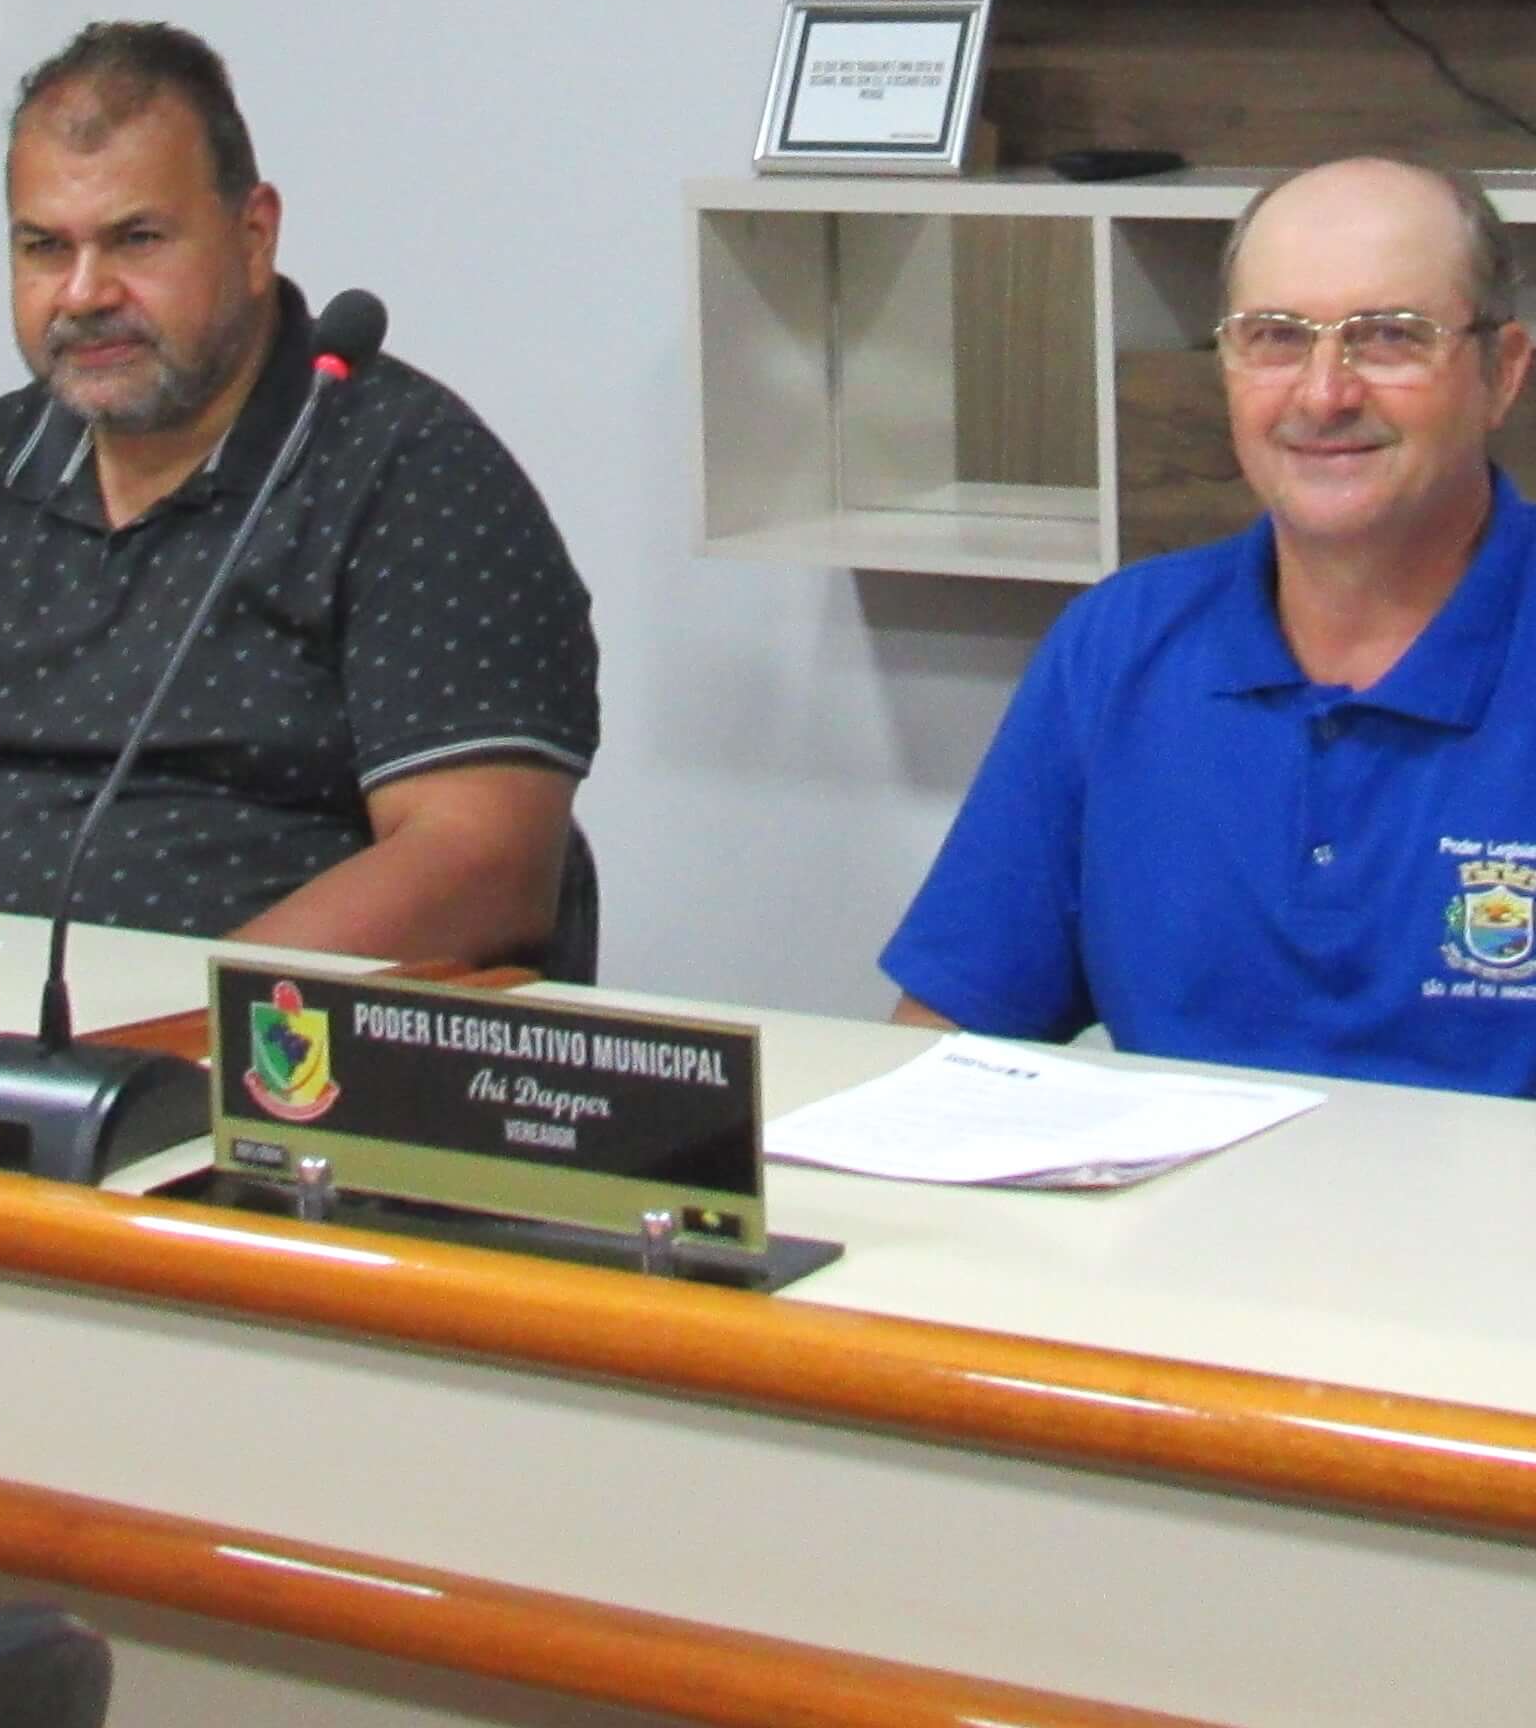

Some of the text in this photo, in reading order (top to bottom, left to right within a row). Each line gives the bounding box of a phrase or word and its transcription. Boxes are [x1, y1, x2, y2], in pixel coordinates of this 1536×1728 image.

[353, 1002, 729, 1087] PODER LEGISLATIVO MUNICIPAL
[513, 1075, 612, 1120] Dapper
[504, 1120, 577, 1151] VEREADOR
